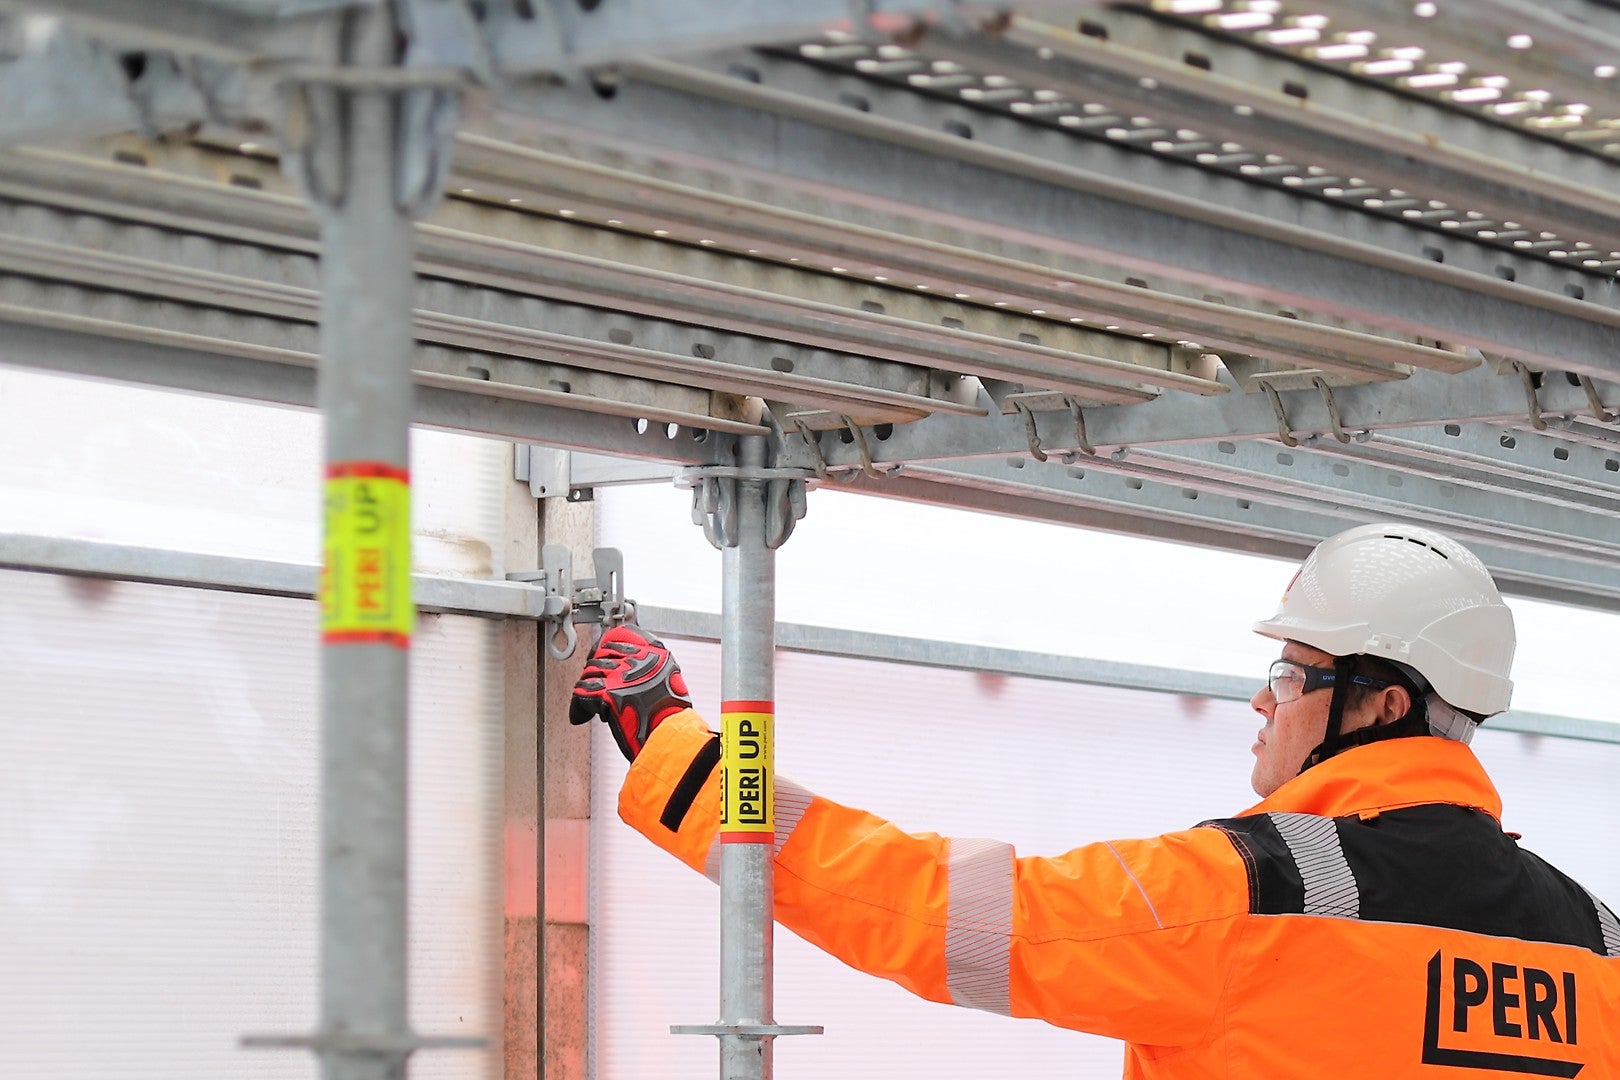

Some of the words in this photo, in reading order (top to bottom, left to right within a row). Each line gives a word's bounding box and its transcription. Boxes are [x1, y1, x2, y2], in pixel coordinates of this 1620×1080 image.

[356, 483, 380, 535] UP
[739, 719, 760, 760] UP
[739, 768, 760, 815] PERI
[1453, 957, 1578, 1046] PERI
